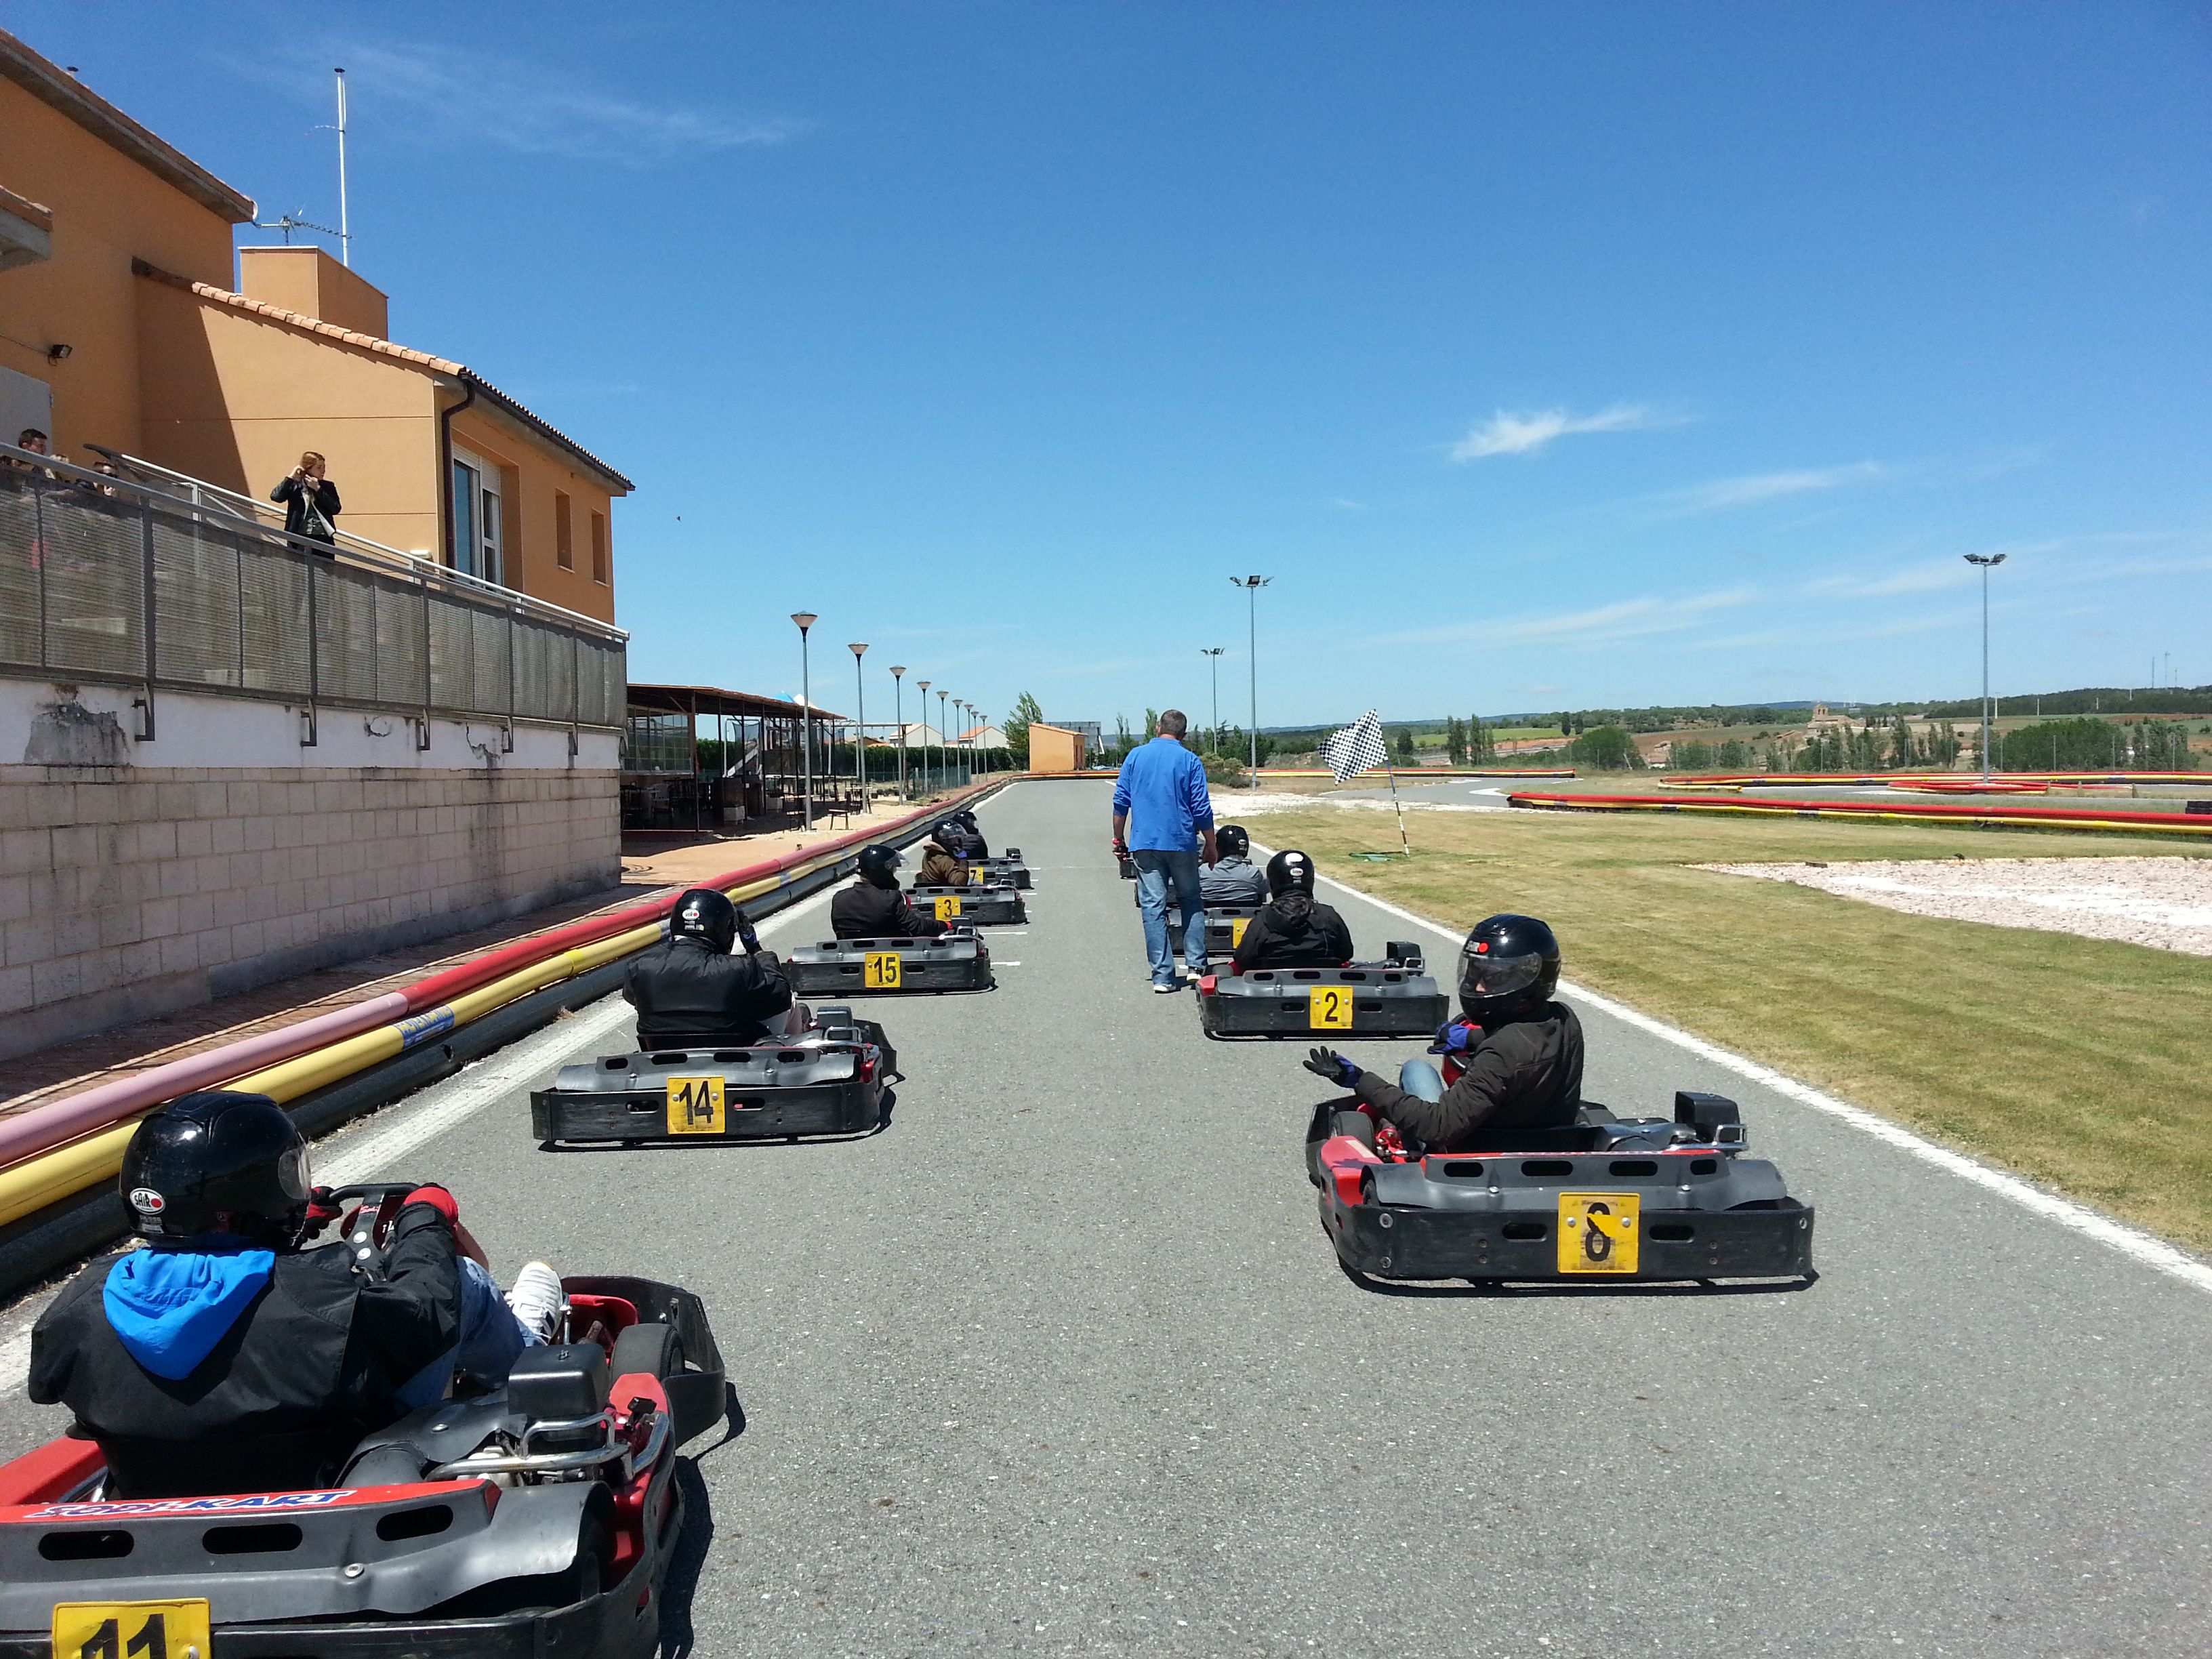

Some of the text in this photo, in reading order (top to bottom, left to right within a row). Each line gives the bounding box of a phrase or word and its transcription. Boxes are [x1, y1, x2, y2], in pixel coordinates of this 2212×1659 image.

[943, 899, 953, 918] 3
[874, 956, 897, 983] 15
[1324, 991, 1338, 1022] 2
[679, 1080, 714, 1125] 14
